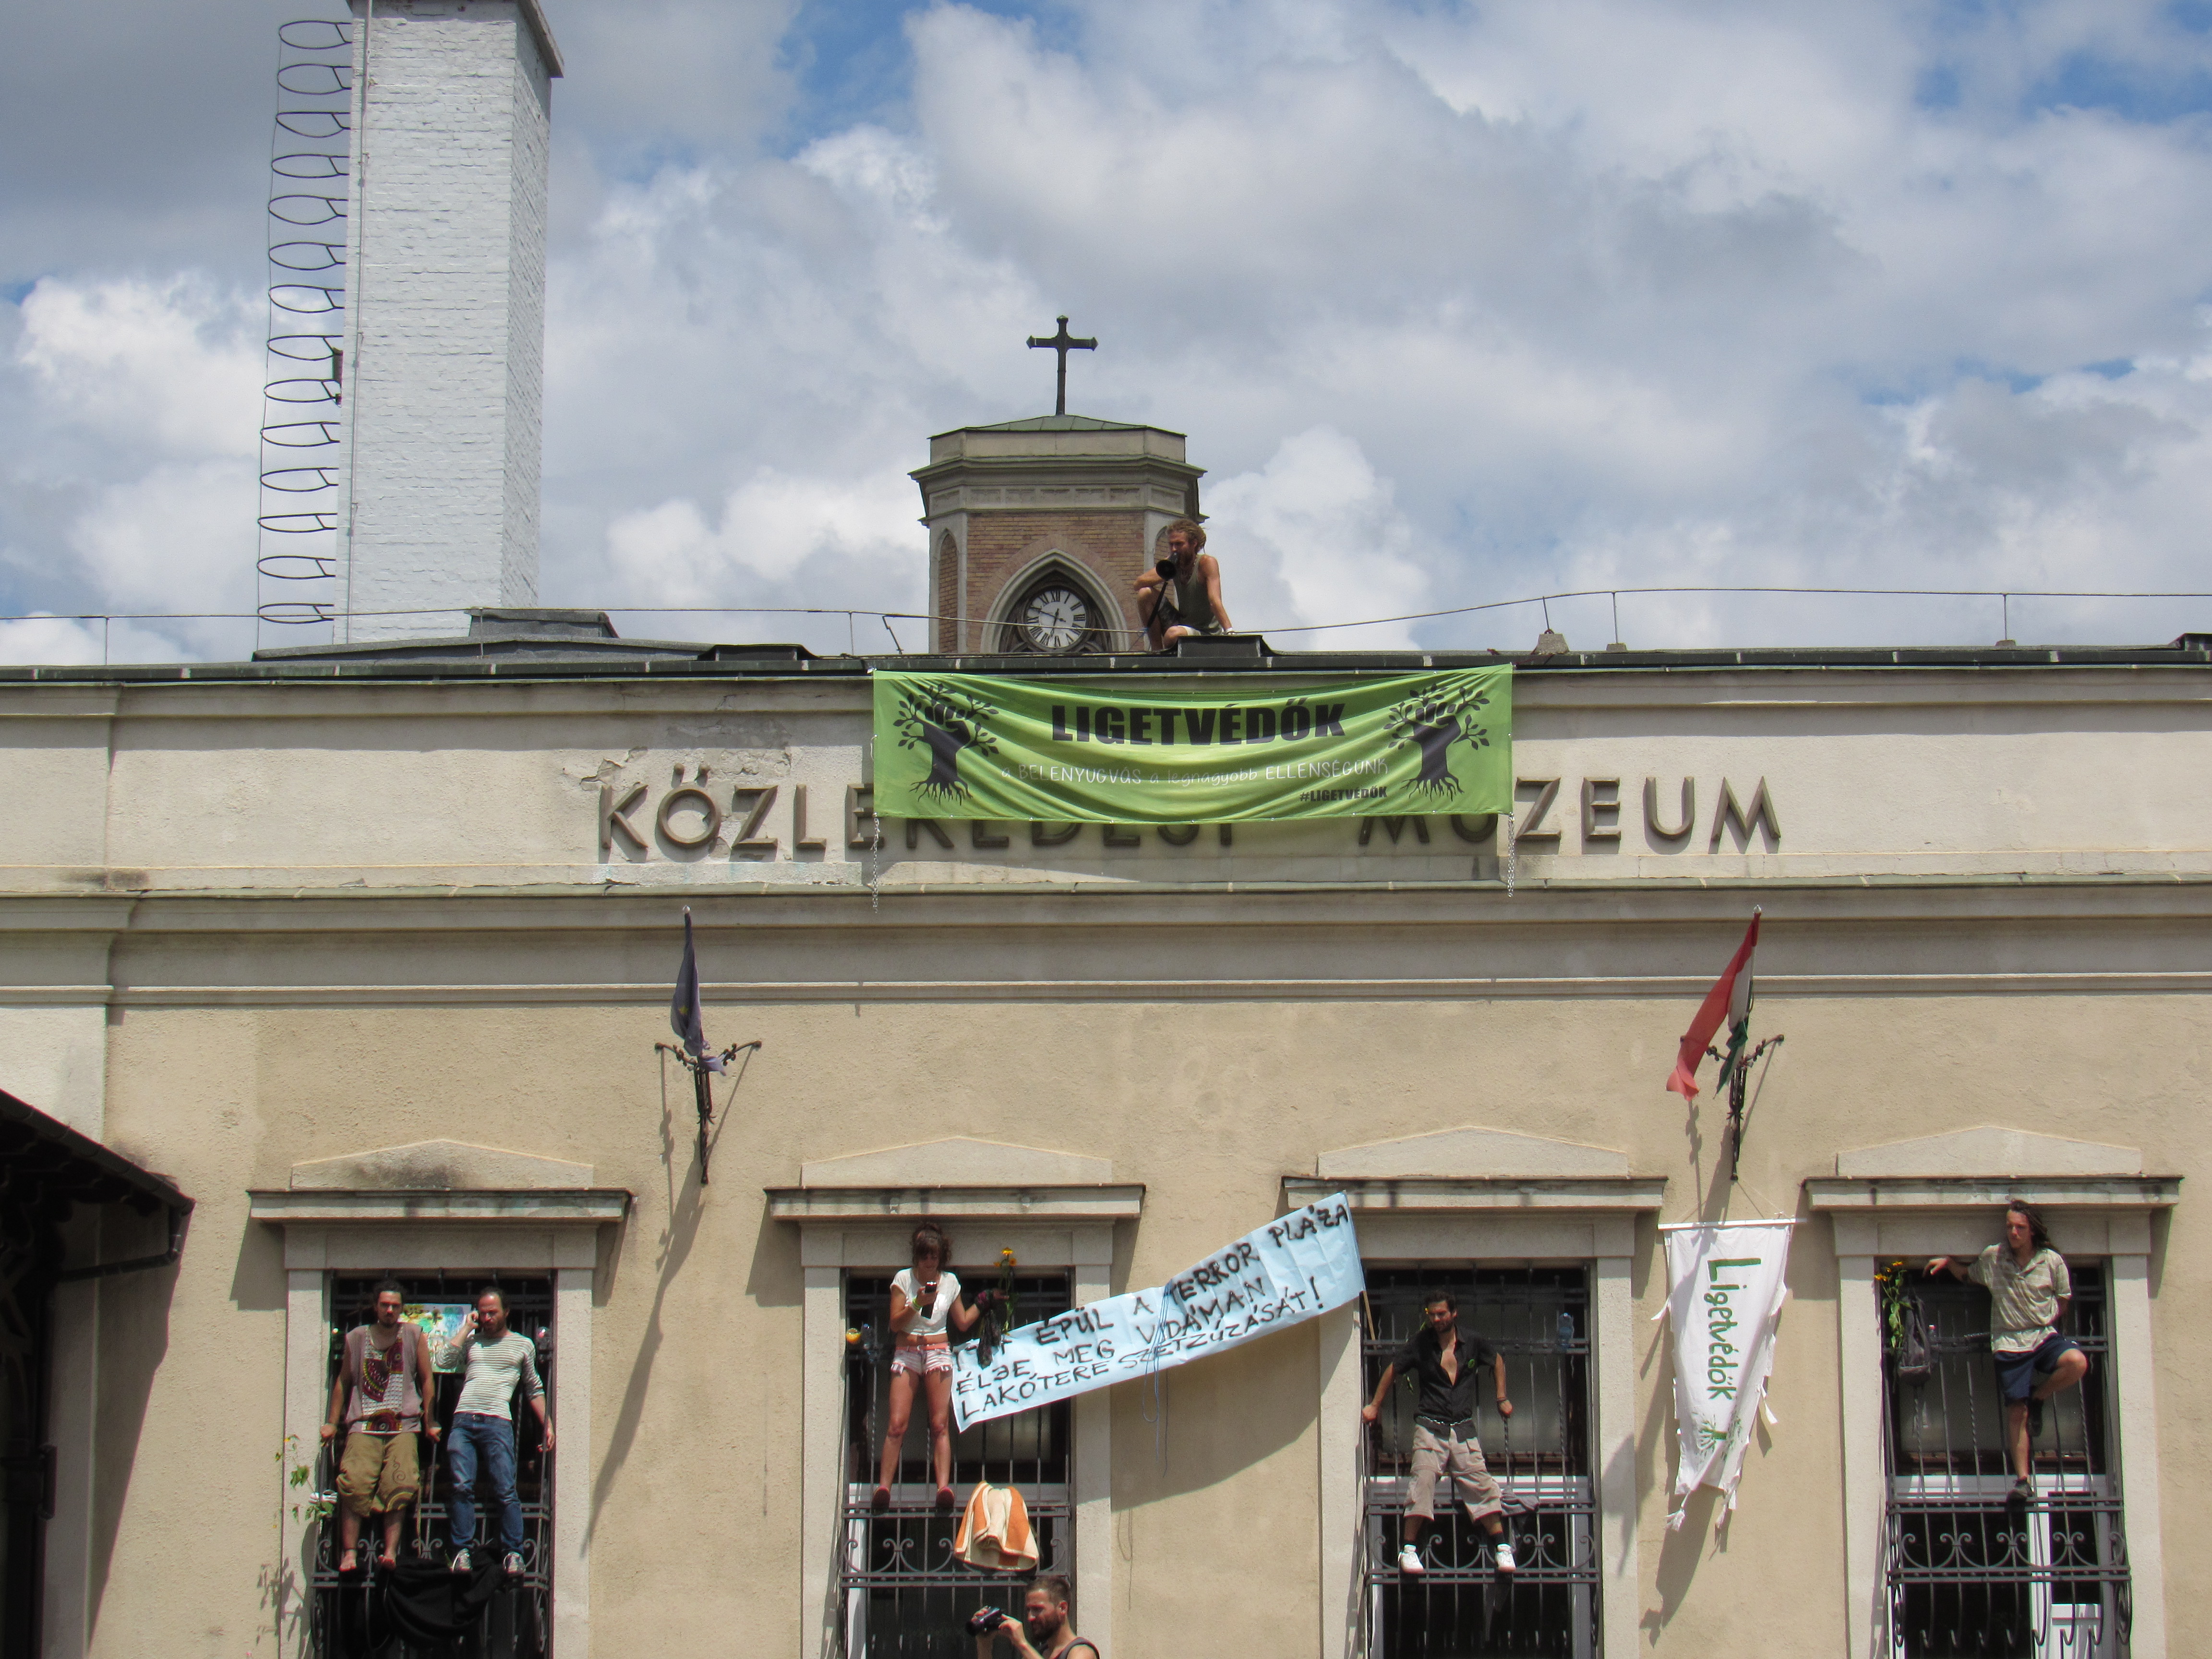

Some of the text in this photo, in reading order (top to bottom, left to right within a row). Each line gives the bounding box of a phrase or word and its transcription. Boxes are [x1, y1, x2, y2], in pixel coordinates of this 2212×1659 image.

[1051, 697, 1346, 745] LIGETVÉDŐK
[1149, 772, 1159, 783] a
[1167, 768, 1258, 786] legnagyobb
[1036, 1307, 1114, 1345] ÉPÜL
[1133, 1297, 1154, 1315] A
[1268, 1204, 1349, 1248] PLÁZA
[1052, 1339, 1115, 1366] MEG
[961, 1360, 1110, 1421] LAKÓTERE
